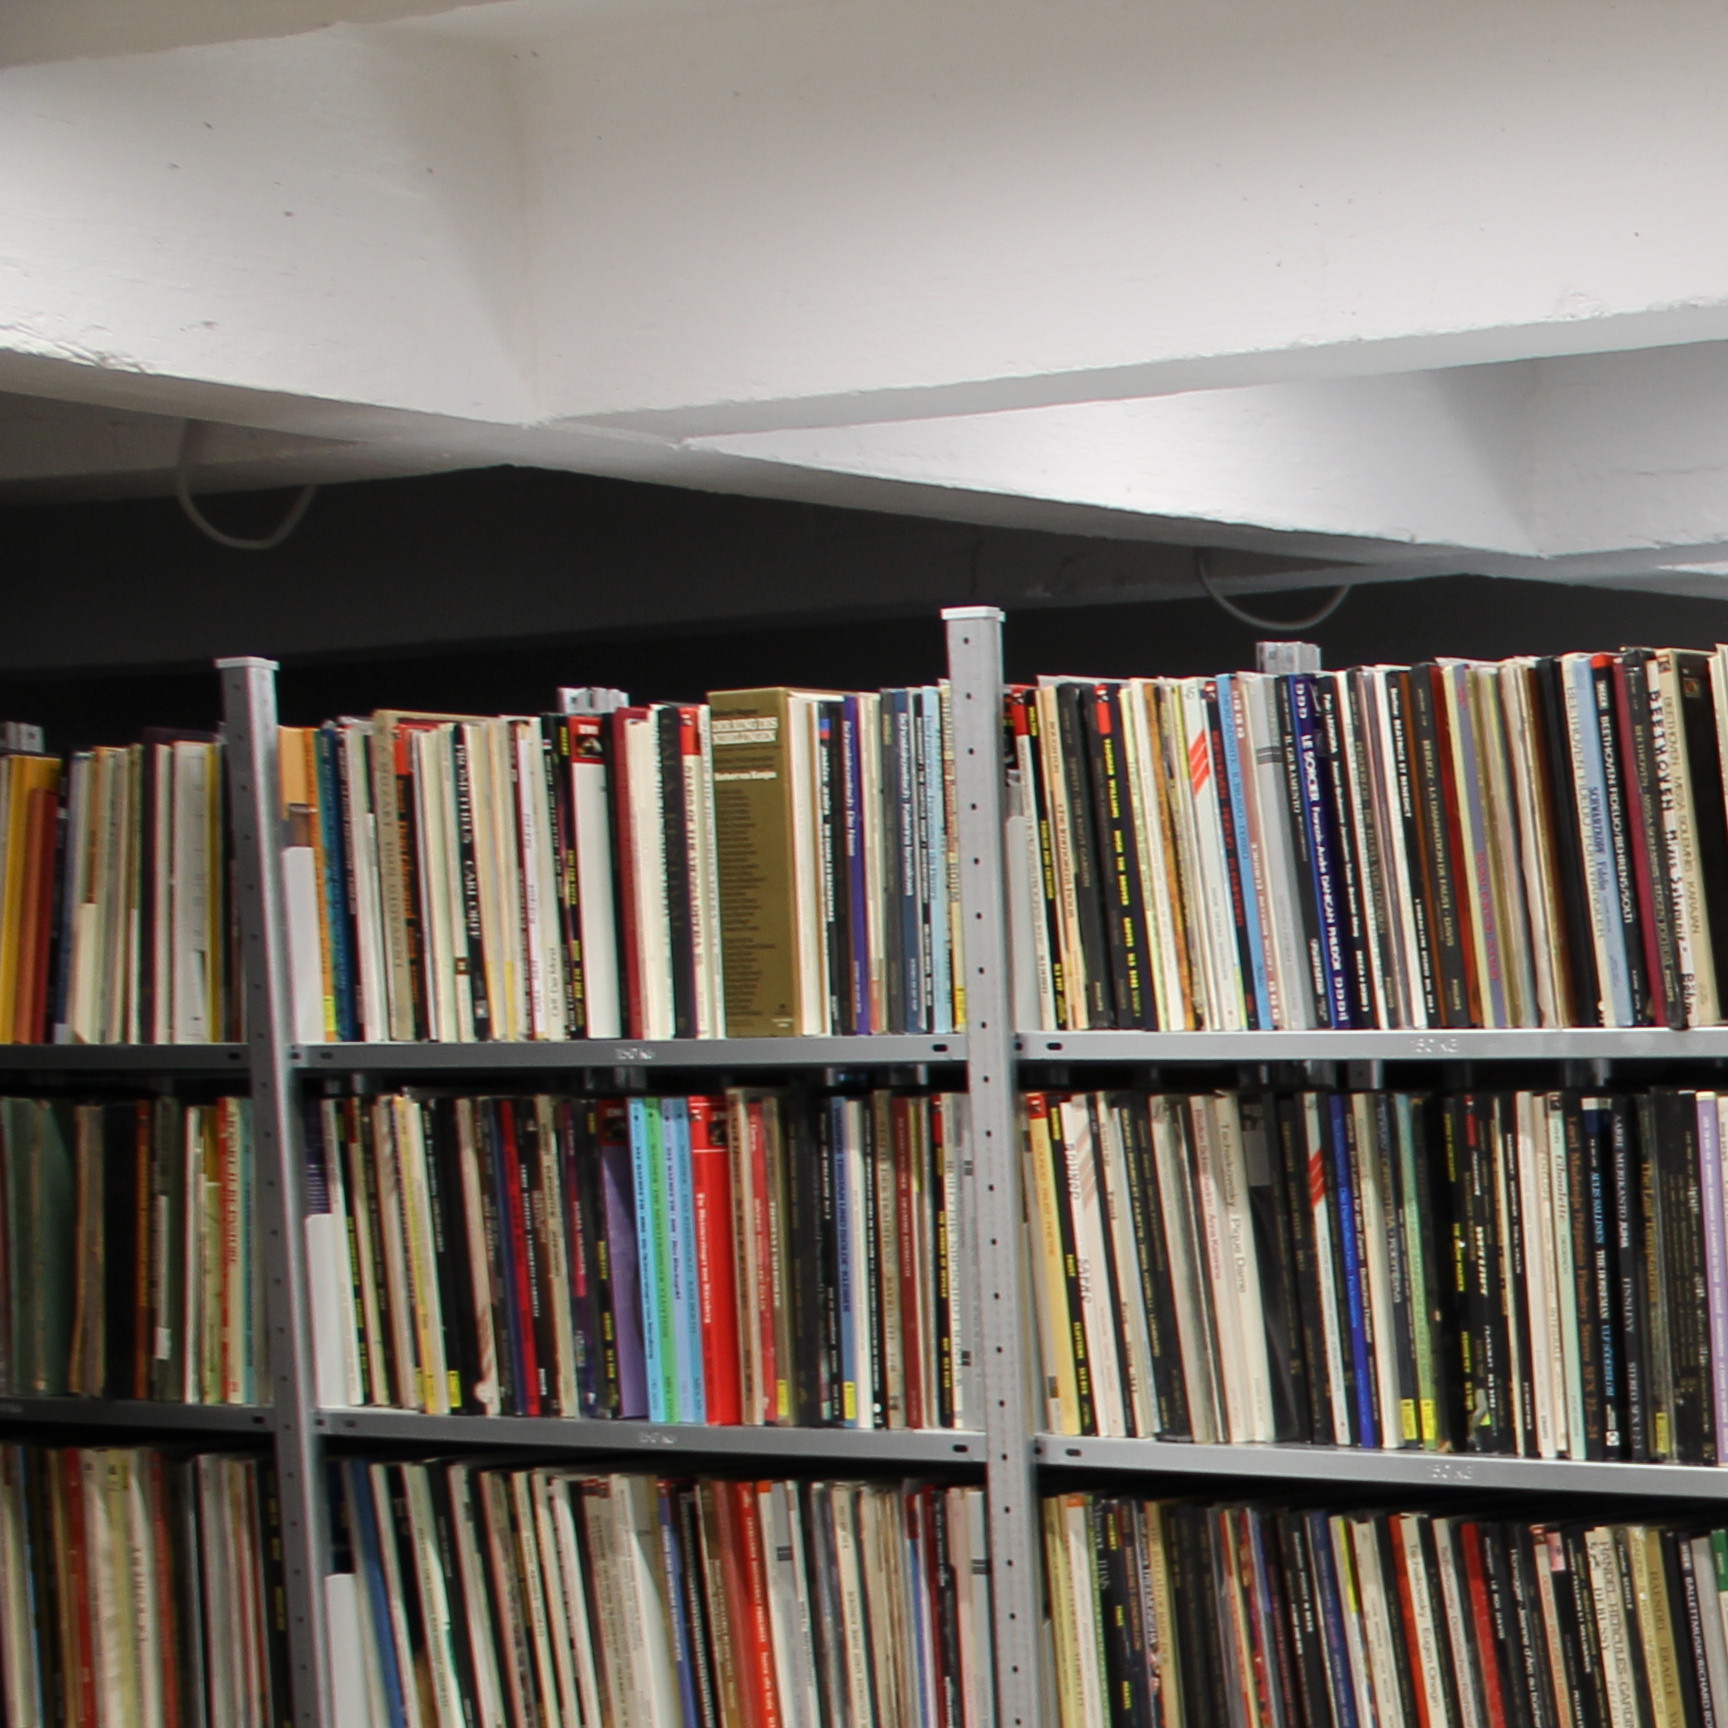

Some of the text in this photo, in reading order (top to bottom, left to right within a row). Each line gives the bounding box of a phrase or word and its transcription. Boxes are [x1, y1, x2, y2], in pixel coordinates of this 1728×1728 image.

[1301, 735, 1314, 749] LE
[1600, 716, 1618, 785] BEETHOVEN
[1303, 752, 1321, 801] SORCIER
[1319, 876, 1336, 923] DANICAN
[1685, 1577, 1711, 1708] BALLETTMUSIK/RICHARD
